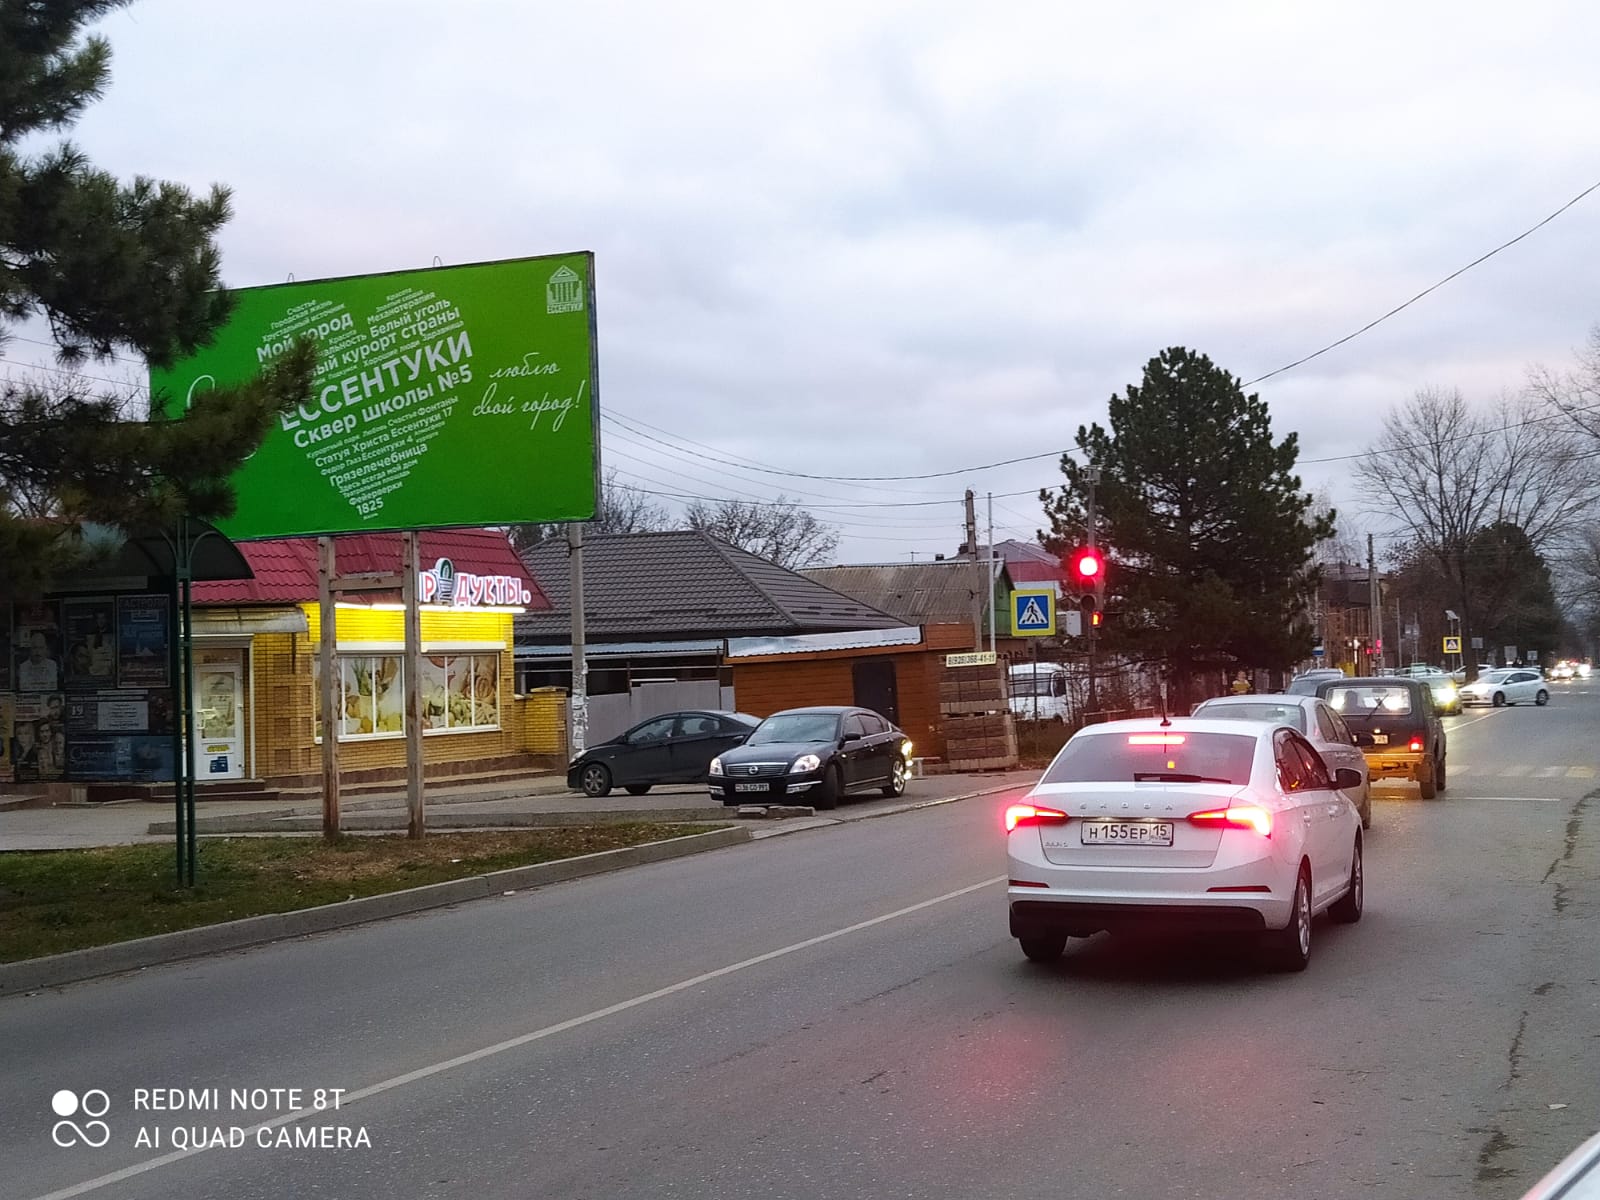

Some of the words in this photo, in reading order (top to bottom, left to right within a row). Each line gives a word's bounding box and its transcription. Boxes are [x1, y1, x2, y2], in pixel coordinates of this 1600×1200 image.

[367, 291, 436, 325] Механотерапия
[369, 312, 412, 338] Белый
[414, 299, 451, 321] уголь
[256, 333, 296, 363] Мой
[341, 332, 397, 364] курорт
[401, 307, 461, 339] страны
[488, 351, 561, 378] люблю
[293, 413, 358, 448] Сквер
[361, 382, 434, 423] школы
[436, 364, 473, 393] №5
[417, 395, 459, 416] Фонтаны
[520, 379, 586, 433] город!
[315, 448, 351, 467] Статуя
[352, 433, 390, 453] Христа
[390, 412, 442, 438] Ессентуки
[442, 406, 453, 418] 17
[361, 440, 406, 461] Ессентуки
[329, 442, 428, 488] Грязелечебница
[356, 497, 384, 515] 1825
[1152, 825, 1168, 836] 15
